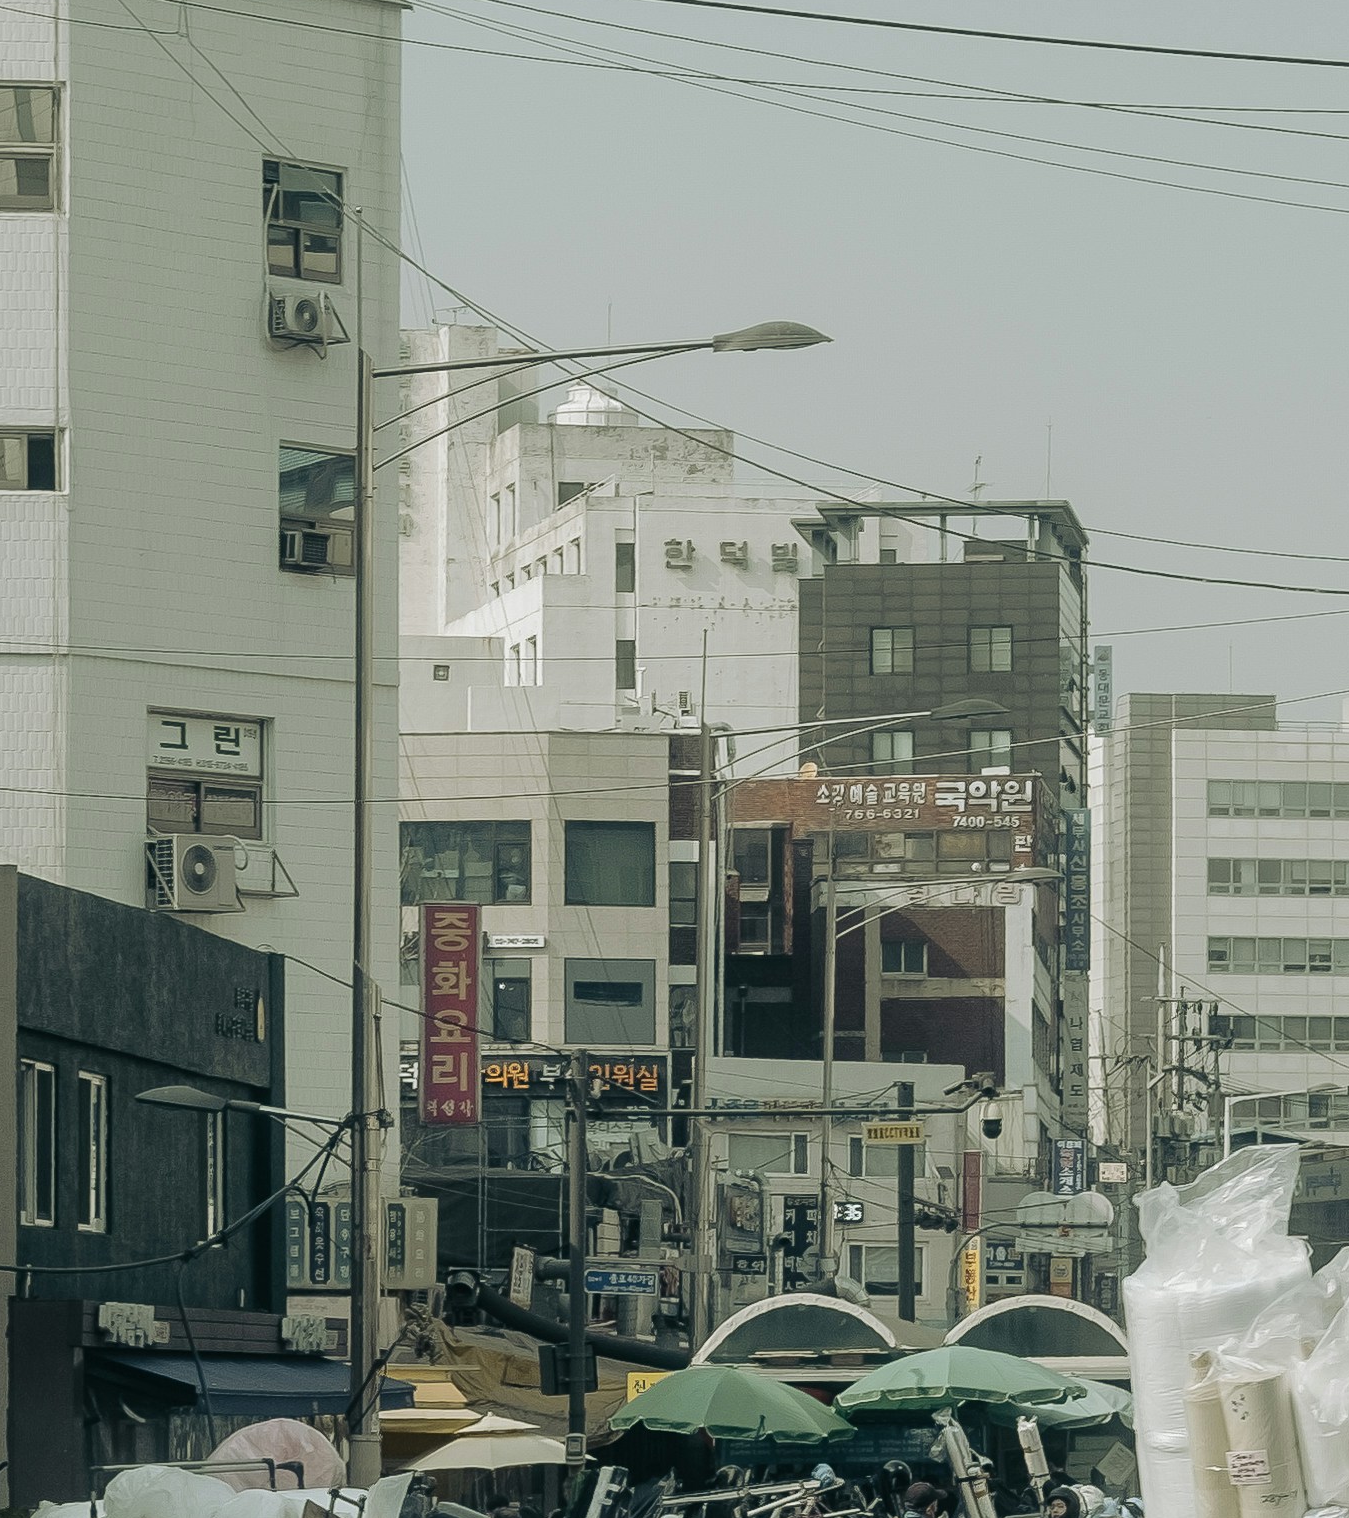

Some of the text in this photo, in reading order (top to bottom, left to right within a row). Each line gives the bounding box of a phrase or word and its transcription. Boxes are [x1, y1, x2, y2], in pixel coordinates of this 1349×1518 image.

[844, 808, 920, 820] 766-6321
[934, 780, 1033, 814] 국악원
[429, 911, 474, 1092] 중화요리
